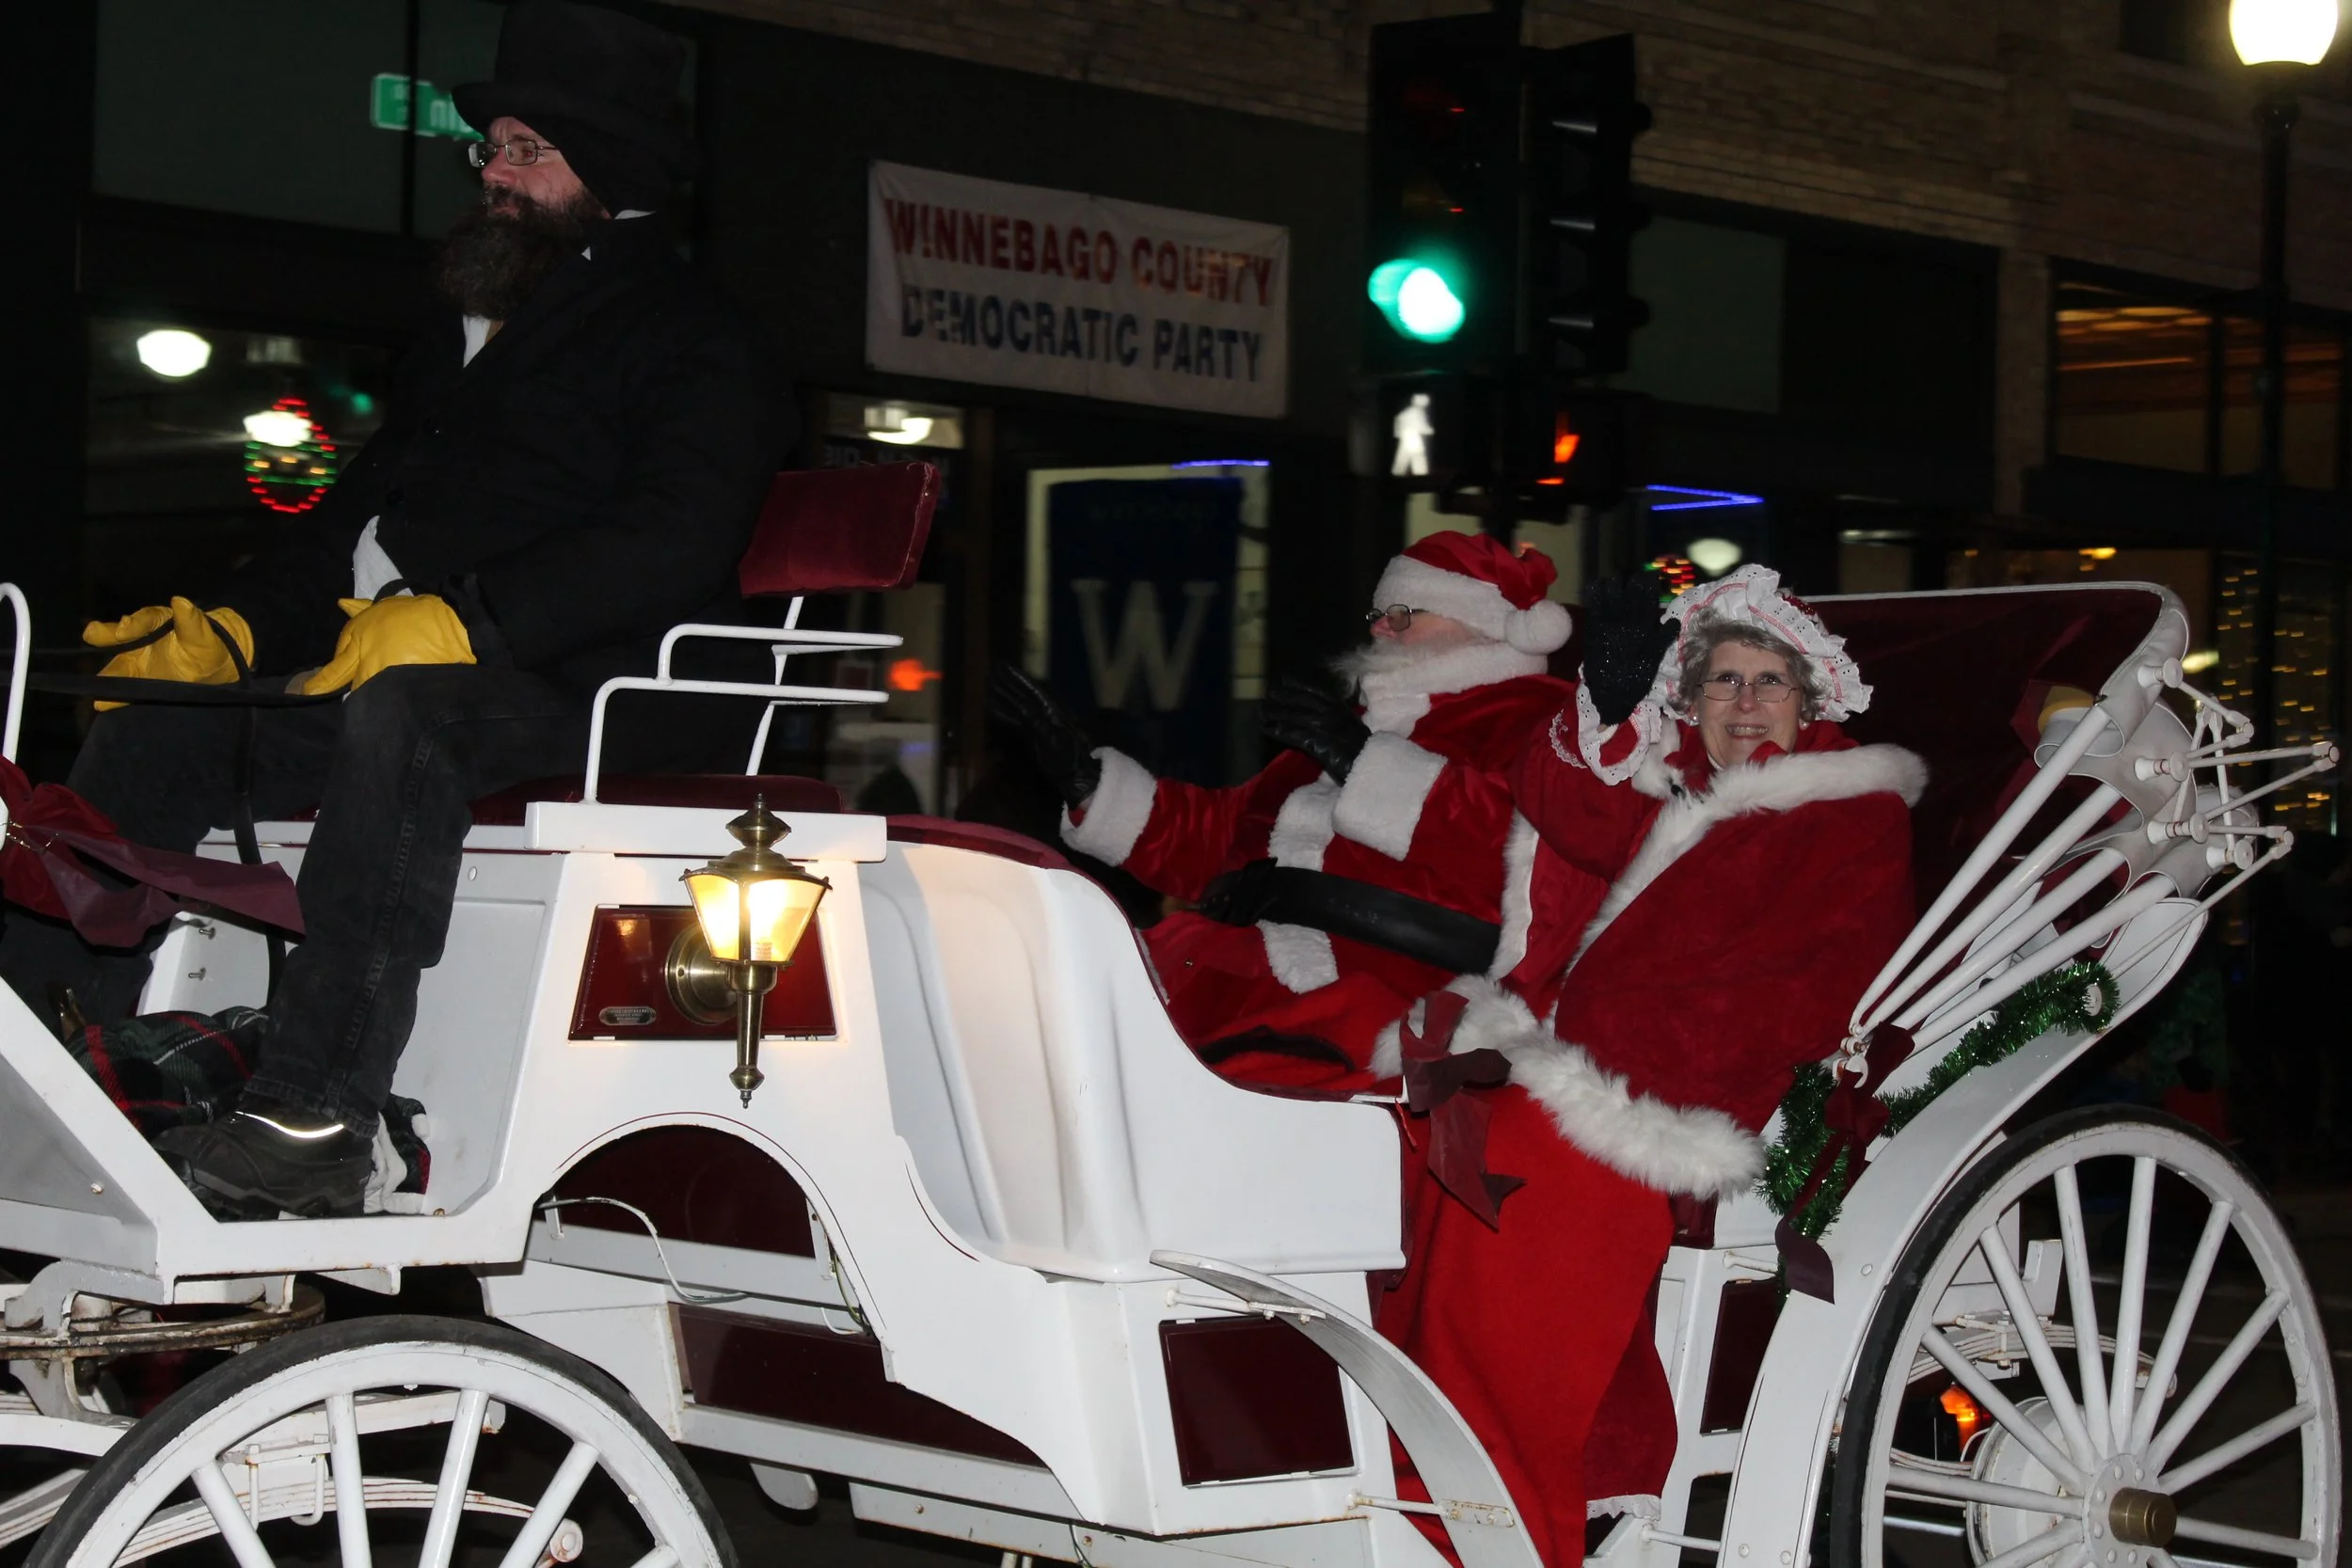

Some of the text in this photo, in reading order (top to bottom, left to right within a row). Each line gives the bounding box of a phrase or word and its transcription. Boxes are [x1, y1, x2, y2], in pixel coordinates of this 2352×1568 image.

[884, 198, 1273, 307] WINNEBAGO COUNTY
[902, 285, 1263, 382] DEMOCRATIC PARTY
[1070, 578, 1219, 711] W
